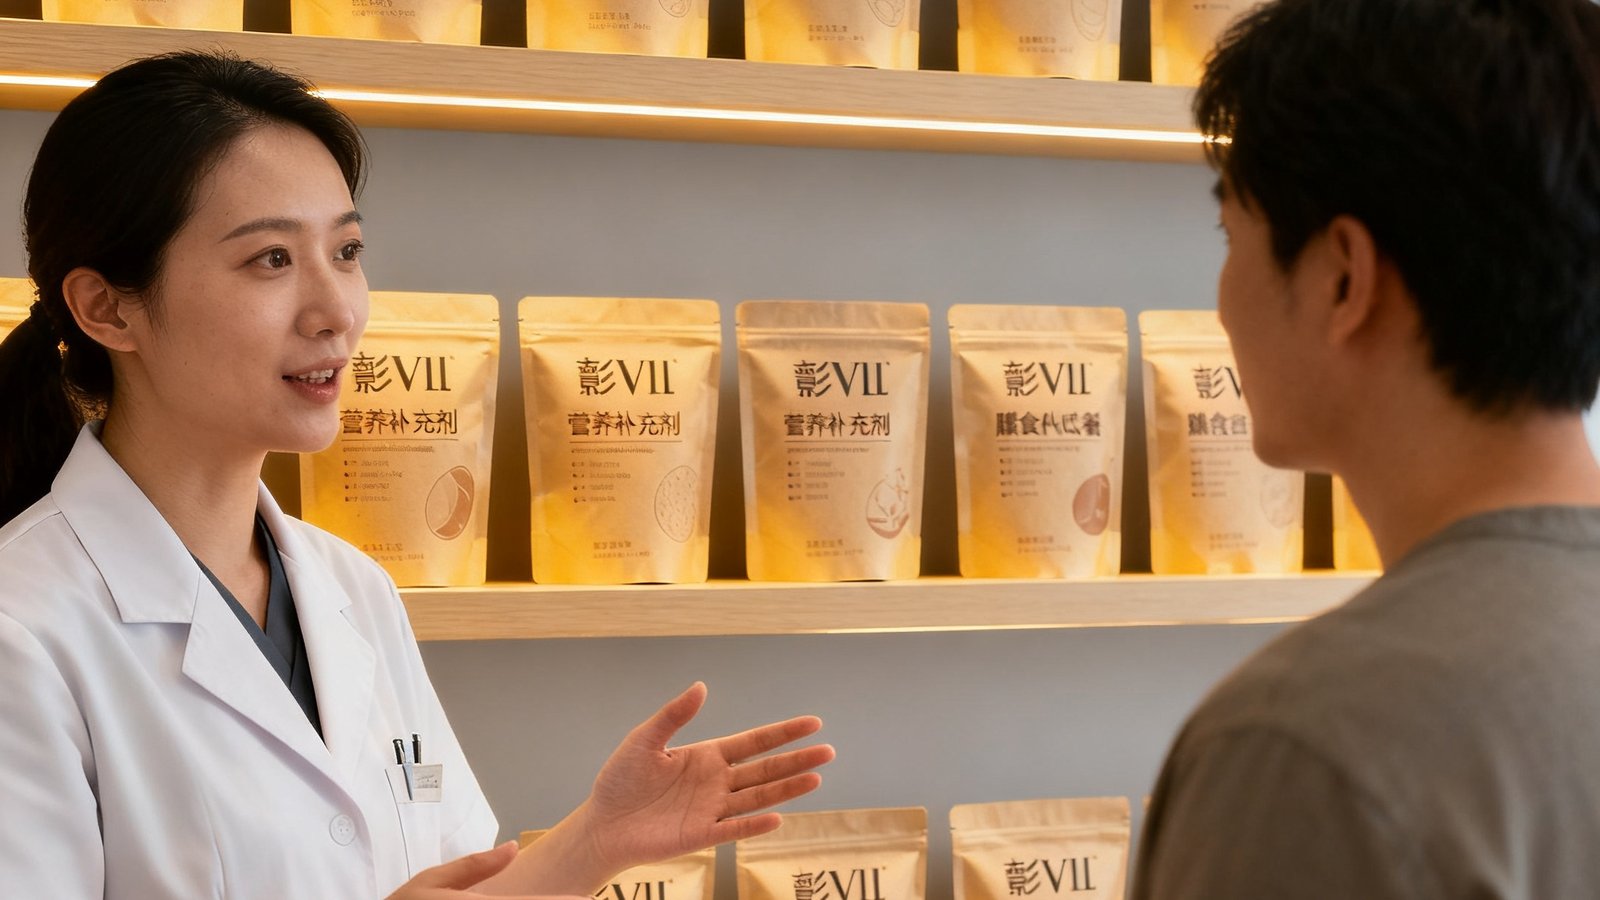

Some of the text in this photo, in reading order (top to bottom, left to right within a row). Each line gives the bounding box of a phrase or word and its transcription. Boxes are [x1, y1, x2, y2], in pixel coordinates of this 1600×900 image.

[340, 408, 457, 435] 营养补充剂
[568, 410, 680, 437] 营养补充剂
